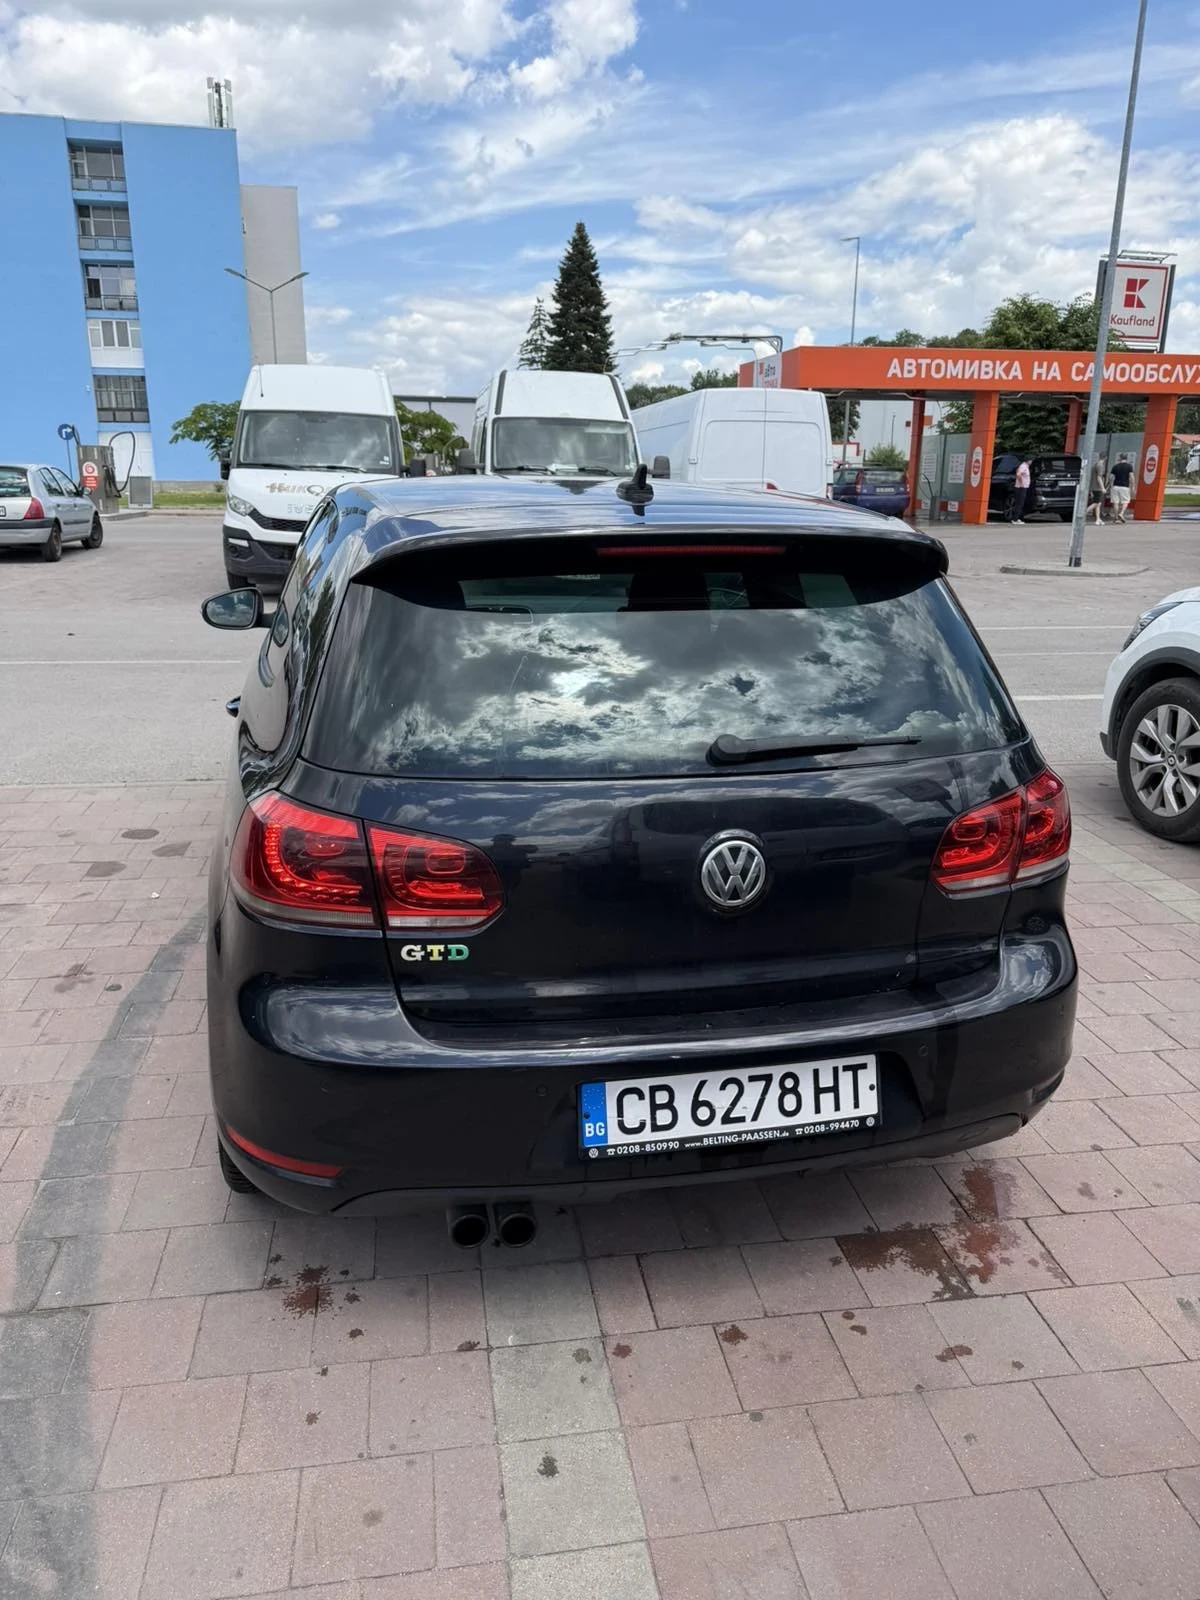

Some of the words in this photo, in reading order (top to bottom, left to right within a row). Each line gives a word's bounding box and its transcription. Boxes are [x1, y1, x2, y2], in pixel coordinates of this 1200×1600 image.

[1110, 314, 1156, 327] Kaufland
[887, 358, 1023, 381] АВТОМИВКА
[1032, 361, 1062, 381] НА
[400, 944, 469, 961] GTD
[615, 1084, 678, 1135] CB
[690, 1071, 802, 1127] 6278
[812, 1062, 868, 1115] HT
[585, 1122, 605, 1137] BG
[684, 1130, 789, 1148] www.BELTING-PAASSEN.de
